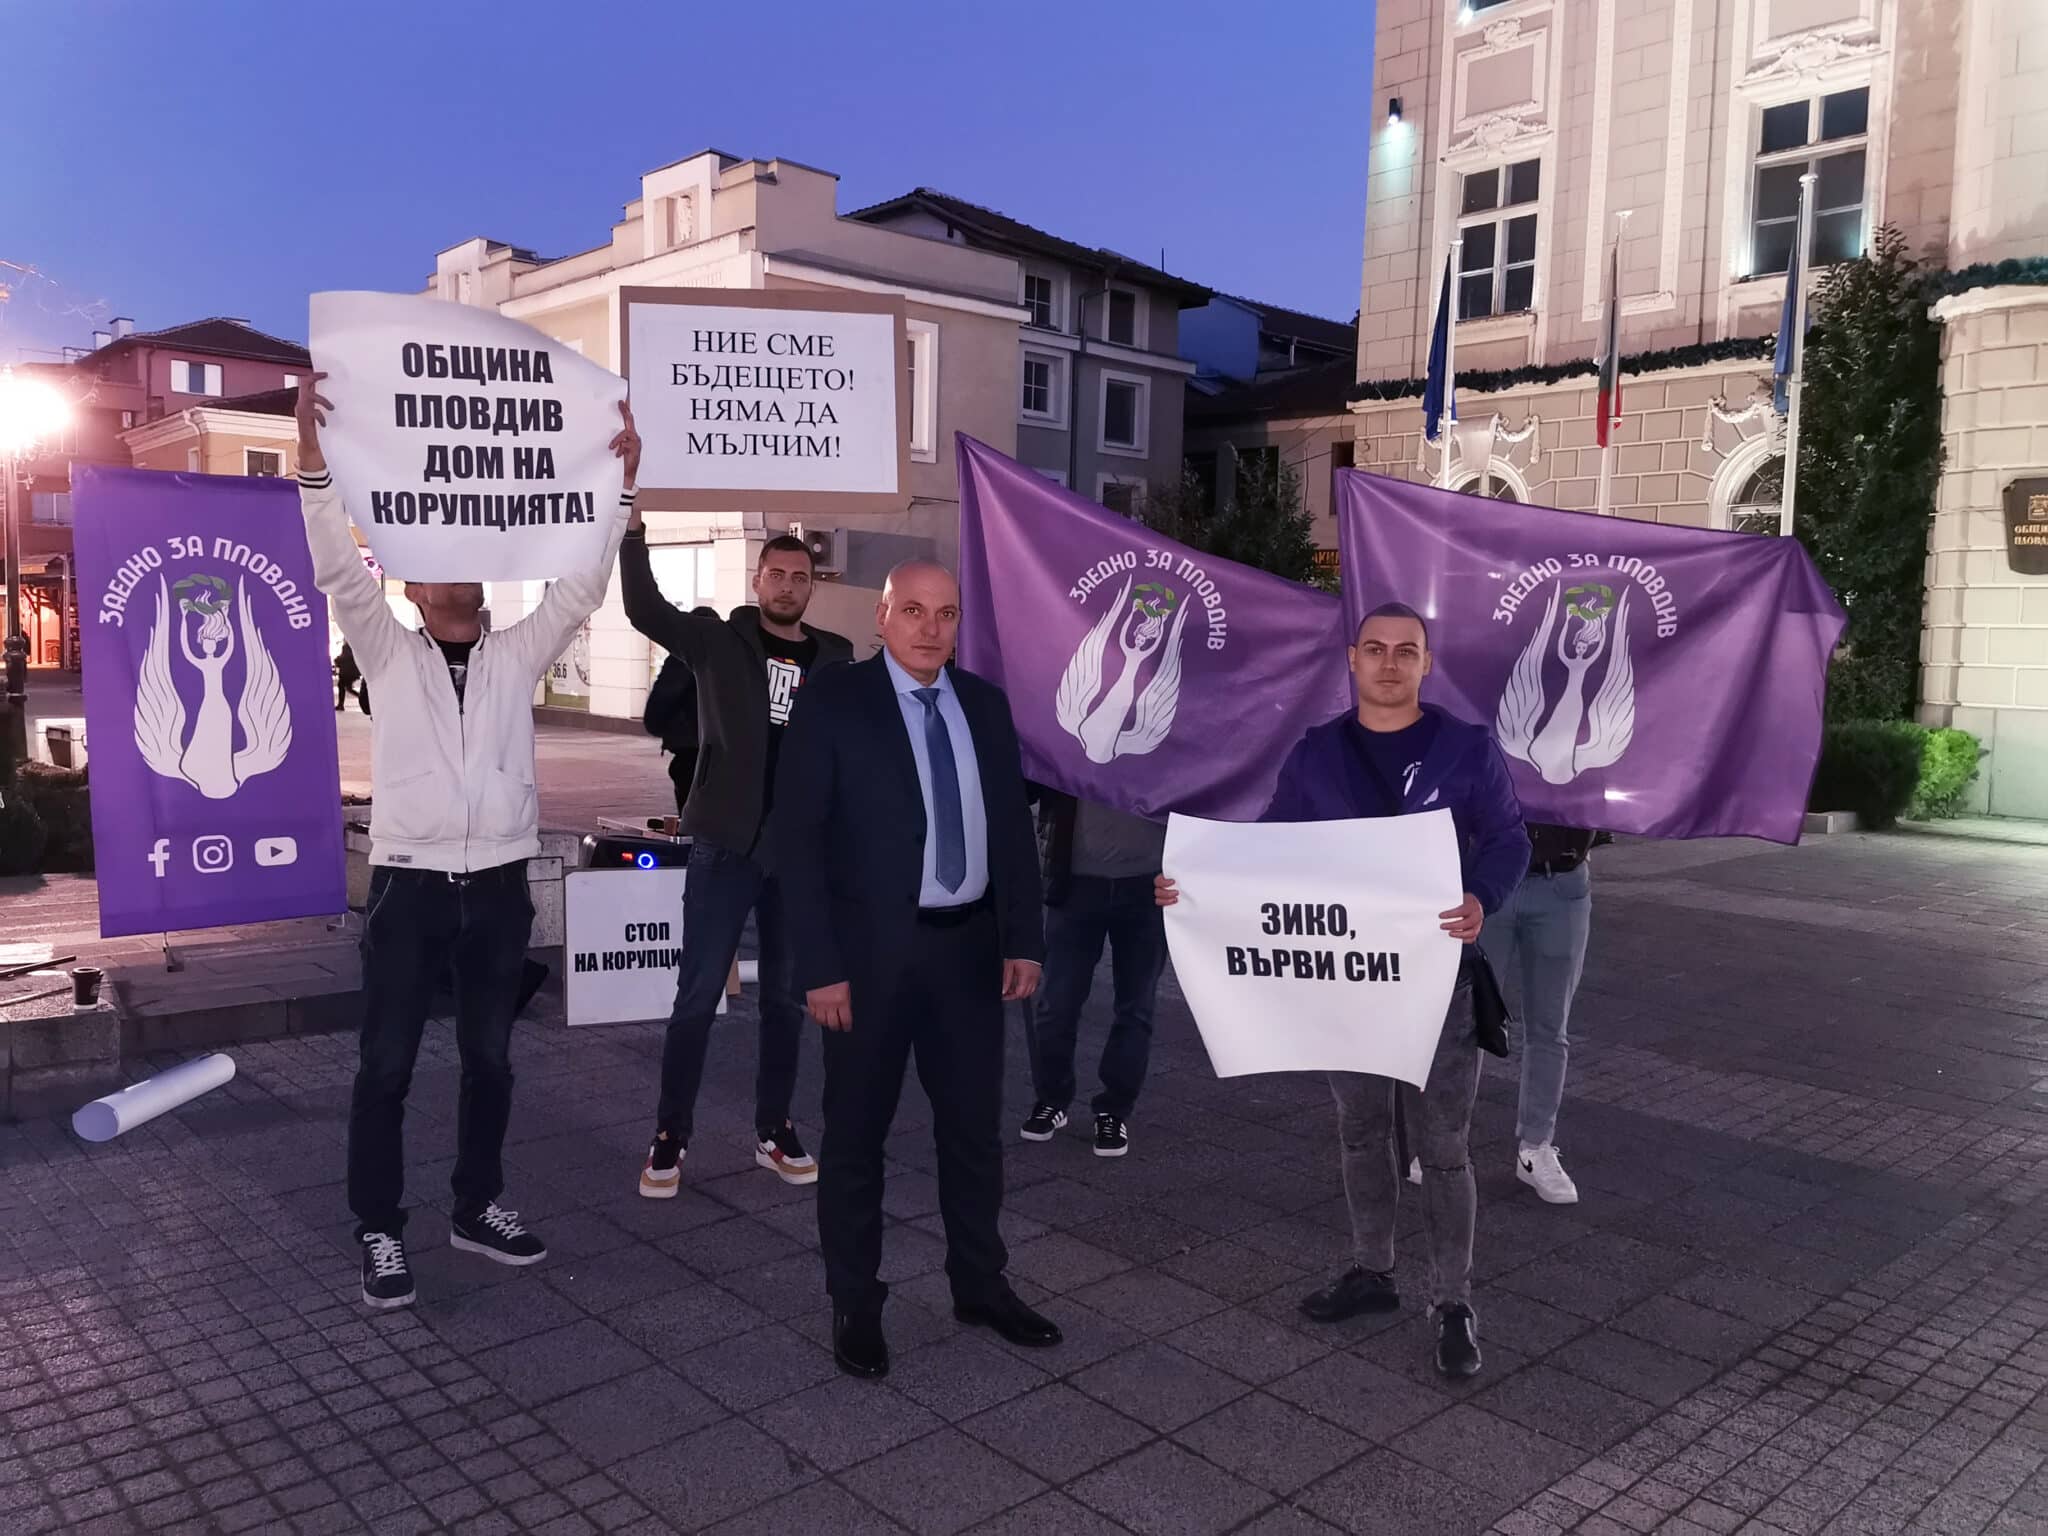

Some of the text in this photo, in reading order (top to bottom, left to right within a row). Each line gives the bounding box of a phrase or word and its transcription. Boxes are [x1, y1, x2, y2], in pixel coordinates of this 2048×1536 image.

[692, 330, 835, 357] НИЕ СМЕ
[402, 342, 554, 386] ОБЩИНА
[671, 363, 854, 393] БЪДЕЩЕТО!
[394, 393, 563, 437] ПЛОВДИВ
[689, 398, 838, 428] НЯМА ДА
[423, 444, 556, 483] ДОМ НА
[686, 432, 840, 458] МЪЛЧИМ!
[371, 490, 596, 532] КОРУПЦИЯТА!
[99, 546, 163, 628] ЗАЕДНО
[167, 535, 204, 560] ЗА
[1069, 550, 1137, 605] ЗАЕДНО
[1144, 549, 1173, 571] ЗА
[1492, 557, 1563, 625] ЗАЕДНО
[1567, 553, 1600, 568] ЗА
[625, 922, 670, 942] СТОП
[1260, 902, 1357, 940] ЗИКО,
[574, 953, 599, 973] НА
[1226, 946, 1401, 982] ВЪРВИ СИ!
